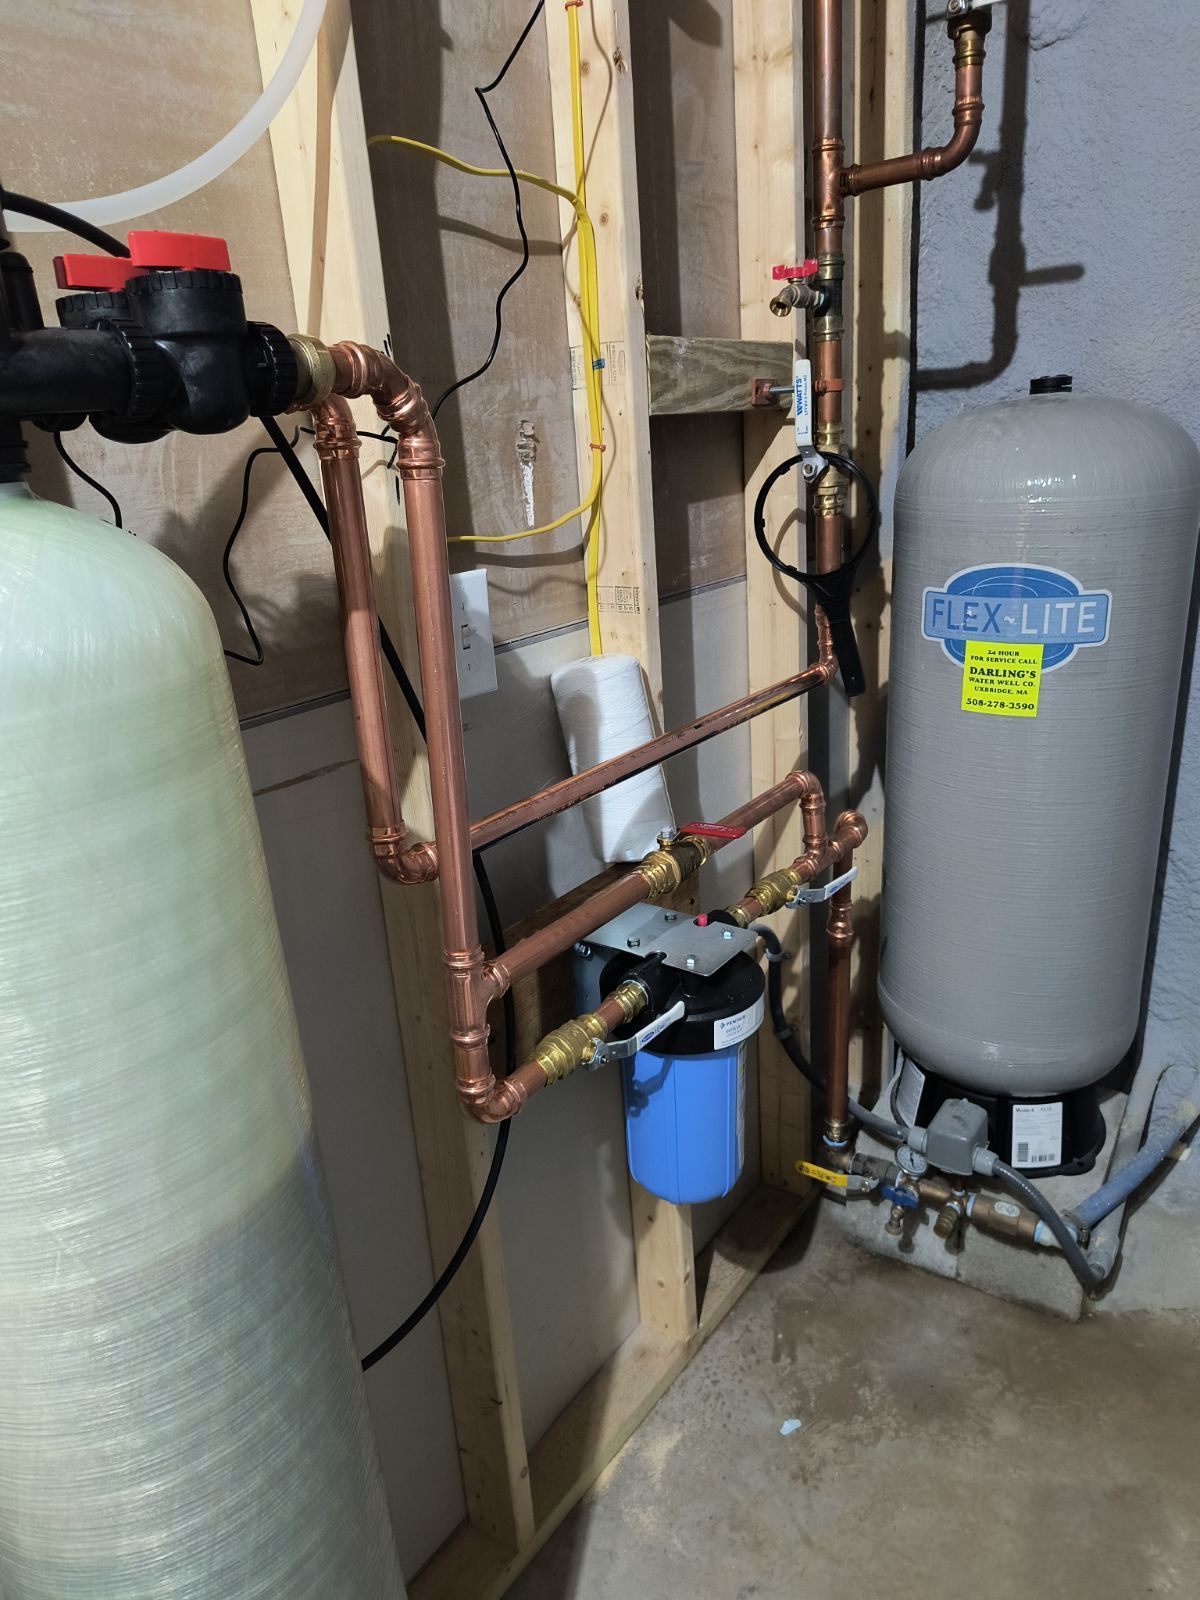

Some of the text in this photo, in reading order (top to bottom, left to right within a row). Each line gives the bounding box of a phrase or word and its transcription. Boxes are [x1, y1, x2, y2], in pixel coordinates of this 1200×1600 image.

[969, 666, 1036, 678] DARLING'S
[969, 677, 995, 685] WATER
[966, 698, 1034, 710] 508-278-3590
